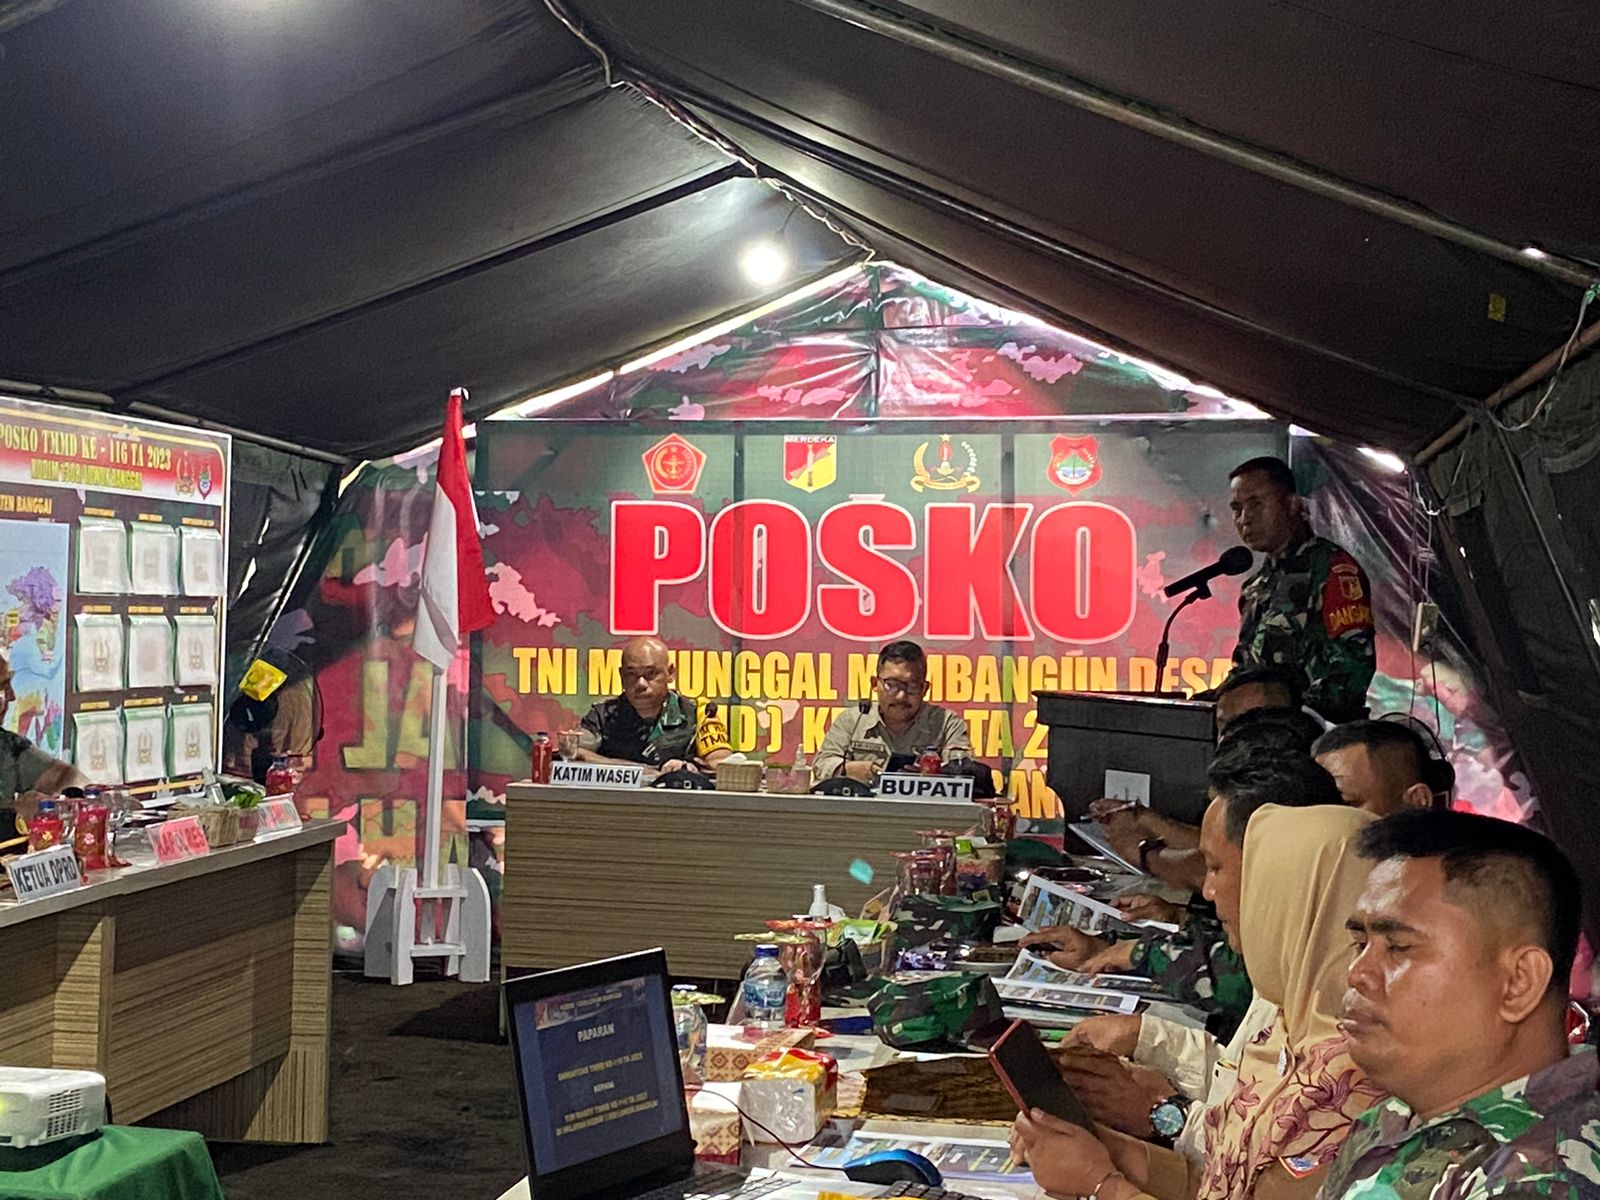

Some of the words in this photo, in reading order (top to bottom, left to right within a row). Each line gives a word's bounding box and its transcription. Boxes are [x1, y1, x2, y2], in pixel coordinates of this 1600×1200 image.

[81, 434, 98, 460] KE
[131, 443, 144, 467] TA
[147, 446, 172, 471] 2023
[610, 499, 1137, 645] POSKO
[513, 648, 577, 695] TNI
[588, 648, 838, 700] MUNGGAL
[963, 709, 1014, 757] TA
[553, 766, 593, 782] KATIM
[596, 768, 640, 784] WASEV
[881, 779, 971, 798] BUPATI
[14, 862, 53, 894] KETUA
[49, 855, 78, 885] DPRD
